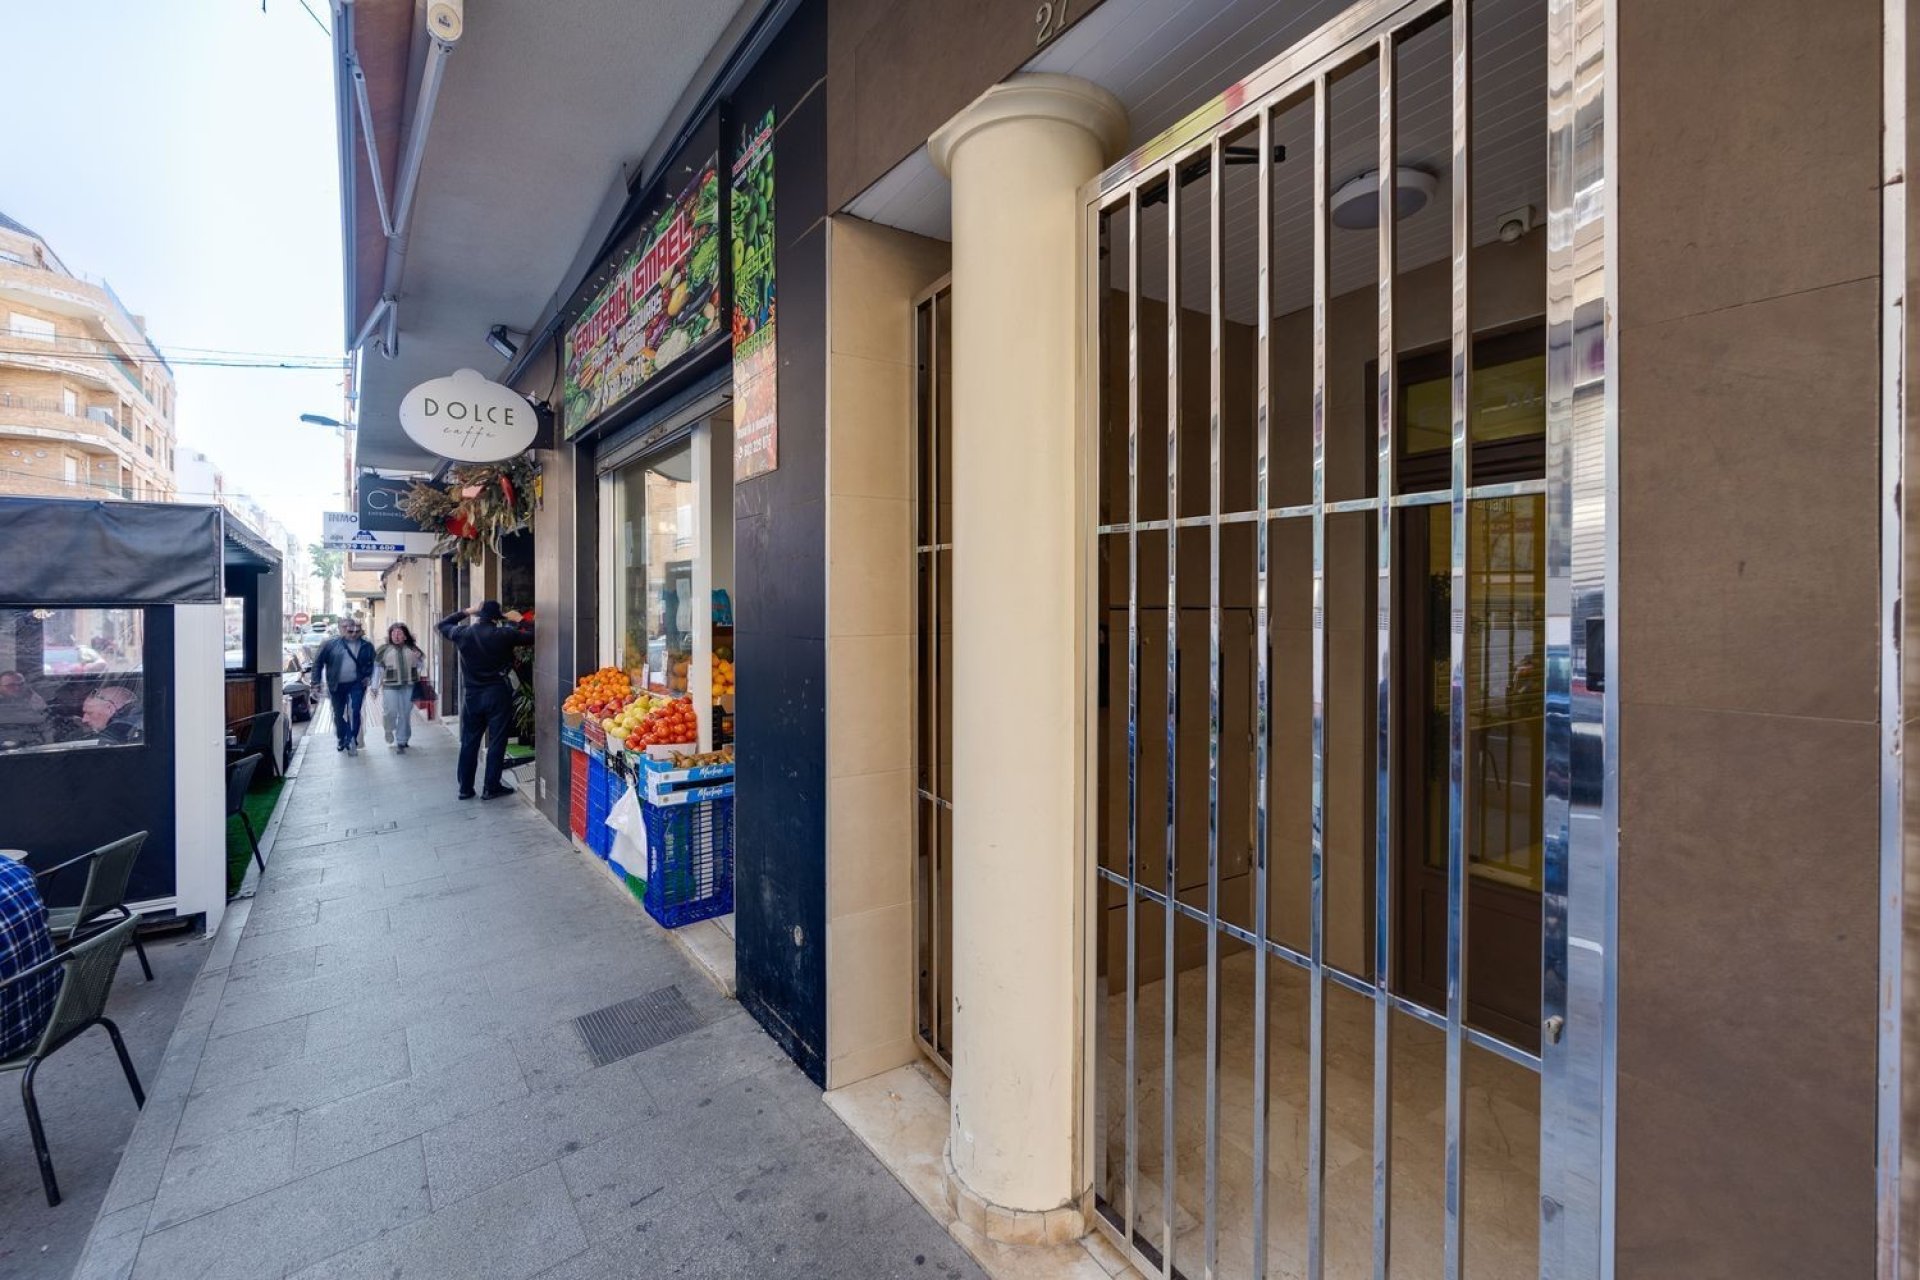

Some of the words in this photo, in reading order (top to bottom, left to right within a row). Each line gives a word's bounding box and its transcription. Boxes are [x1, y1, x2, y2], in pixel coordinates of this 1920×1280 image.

[631, 210, 692, 306] ISMAEL
[734, 240, 771, 292] FRESCO
[424, 397, 514, 426] DOLCE
